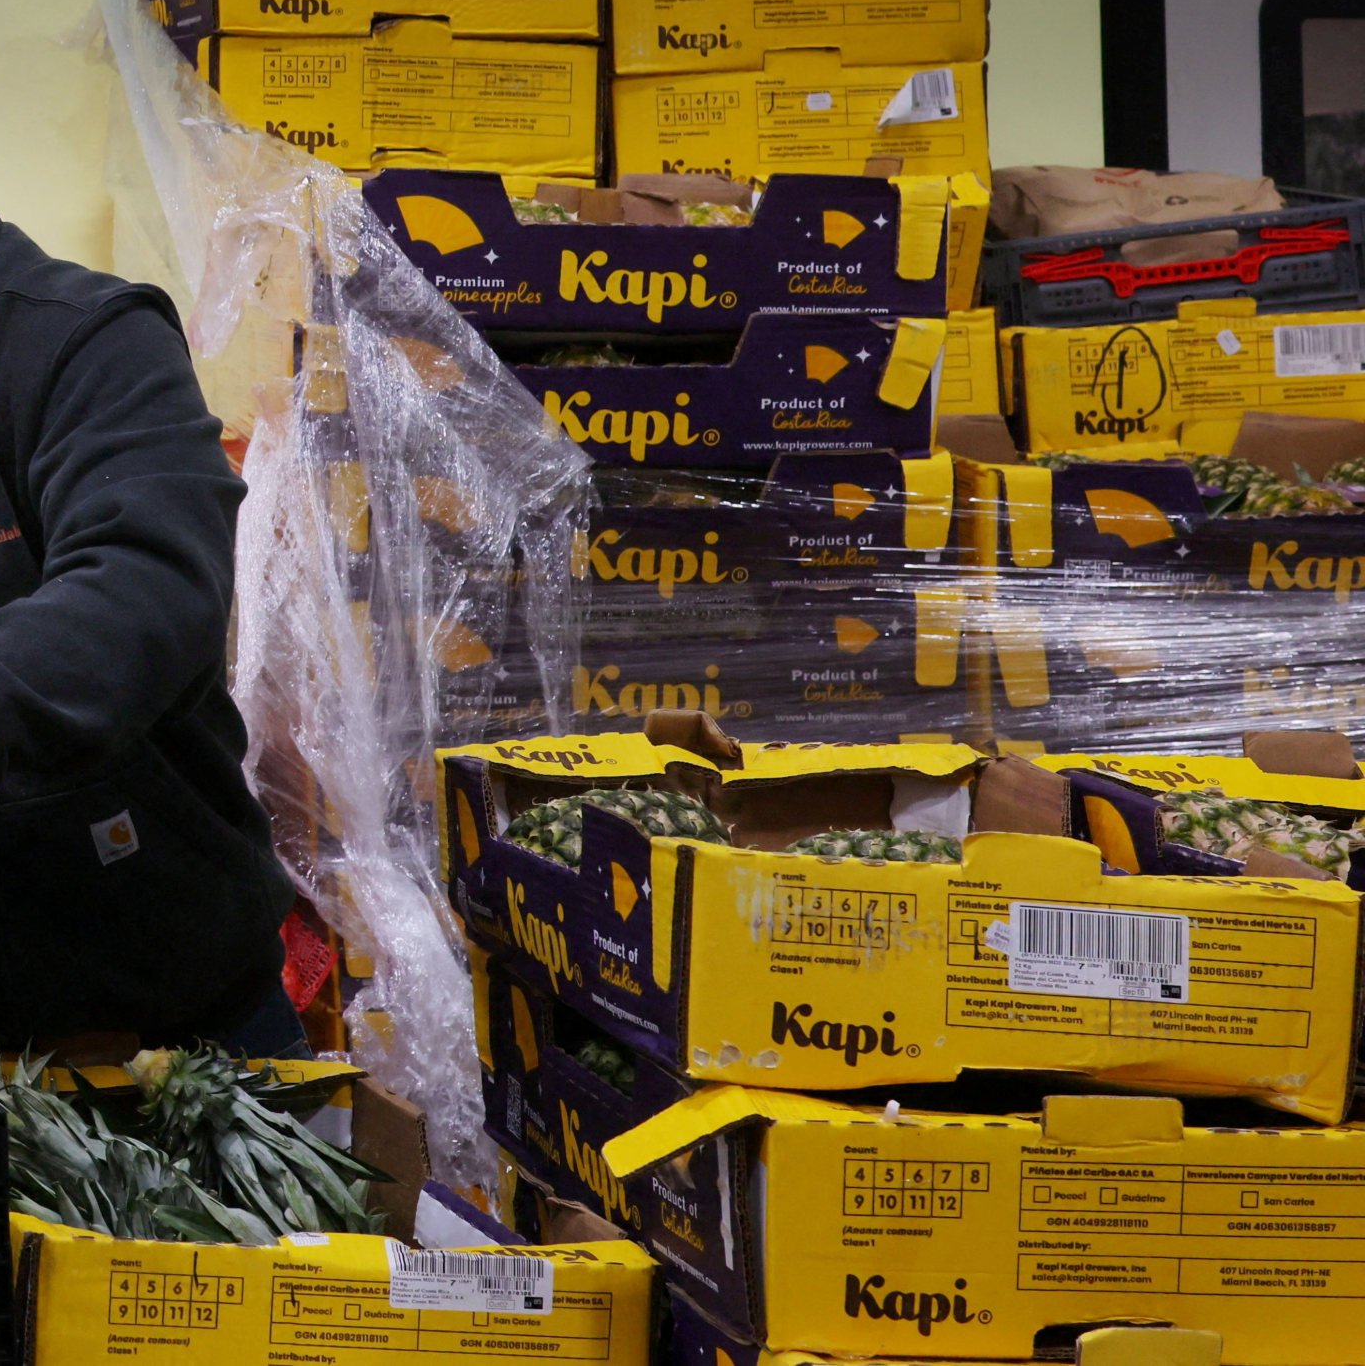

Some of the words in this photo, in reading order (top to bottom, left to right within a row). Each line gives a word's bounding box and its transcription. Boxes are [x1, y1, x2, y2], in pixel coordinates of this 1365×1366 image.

[658, 24, 732, 57] Kapi
[265, 120, 340, 154] Kapi
[777, 262, 840, 274] Product
[846, 262, 862, 274] of
[435, 275, 505, 289] Premium
[559, 250, 716, 323] Kapi
[788, 275, 831, 295] Costa
[442, 282, 542, 314] pineapples
[760, 397, 824, 410] Product
[829, 397, 845, 410] of
[543, 390, 699, 462] Kapi
[772, 410, 816, 431] Costa
[1074, 408, 1149, 442] Kapi
[743, 439, 873, 452] www.kapigrowers.com
[789, 534, 852, 547] Product
[858, 533, 874, 547] of
[571, 528, 729, 599] Kapi
[1122, 568, 1195, 581] Premium
[1248, 540, 1365, 603] Kap
[791, 669, 855, 682] Product
[861, 668, 879, 682] of
[571, 663, 732, 718] Kapi
[494, 743, 602, 771] Kapi
[1092, 759, 1205, 787] Kapi
[506, 877, 574, 995] Kapi
[593, 929, 626, 960] Product
[628, 947, 638, 964] of
[771, 1001, 903, 1067] Kapi
[844, 1145, 878, 1155] Count:
[1021, 1145, 1058, 1155] Packed
[1059, 1146, 1077, 1158] by:
[855, 1167, 865, 1182] 4
[884, 1168, 894, 1183] 5
[913, 1168, 923, 1183] 6
[941, 1170, 951, 1184] 7
[970, 1169, 980, 1184] 8
[1066, 1167, 1082, 1177] del
[1083, 1168, 1117, 1177] Caribe
[1118, 1169, 1140, 1178] GAC
[1141, 1169, 1155, 1178] SA
[1186, 1170, 1246, 1181] Inversiones
[1247, 1172, 1288, 1182] Campos
[1288, 1172, 1325, 1182] Verdes
[1325, 1172, 1341, 1182] del
[652, 1177, 686, 1211] Product
[688, 1201, 698, 1218] of
[854, 1195, 864, 1209] 9
[878, 1195, 897, 1210] 10
[910, 1195, 926, 1210] 11
[938, 1196, 956, 1211] 12
[1263, 1197, 1282, 1206] San
[1284, 1197, 1315, 1207] Carlos
[1046, 1217, 1070, 1227] GGN
[1227, 1221, 1251, 1232] GGN
[842, 1225, 883, 1236] (Ananas
[842, 1239, 869, 1247] Class
[1018, 1240, 1074, 1251] Distributed
[1075, 1241, 1091, 1252] by:
[1036, 1261, 1060, 1272] Kapi
[1061, 1262, 1084, 1273] Kapi
[1085, 1263, 1129, 1273] Growers,
[1131, 1264, 1147, 1273] Inc
[1219, 1267, 1237, 1276] 407
[1238, 1267, 1273, 1277] Lincoln
[1274, 1268, 1299, 1277] Road
[1300, 1268, 1332, 1277] PH-NE
[1031, 1273, 1152, 1285] sales@kapigrowers.com
[1221, 1276, 1252, 1286] Miami
[1253, 1277, 1287, 1287] Beach,
[1288, 1279, 1299, 1287] FL
[1300, 1279, 1327, 1288] 33139
[844, 1273, 975, 1337] Kapi
